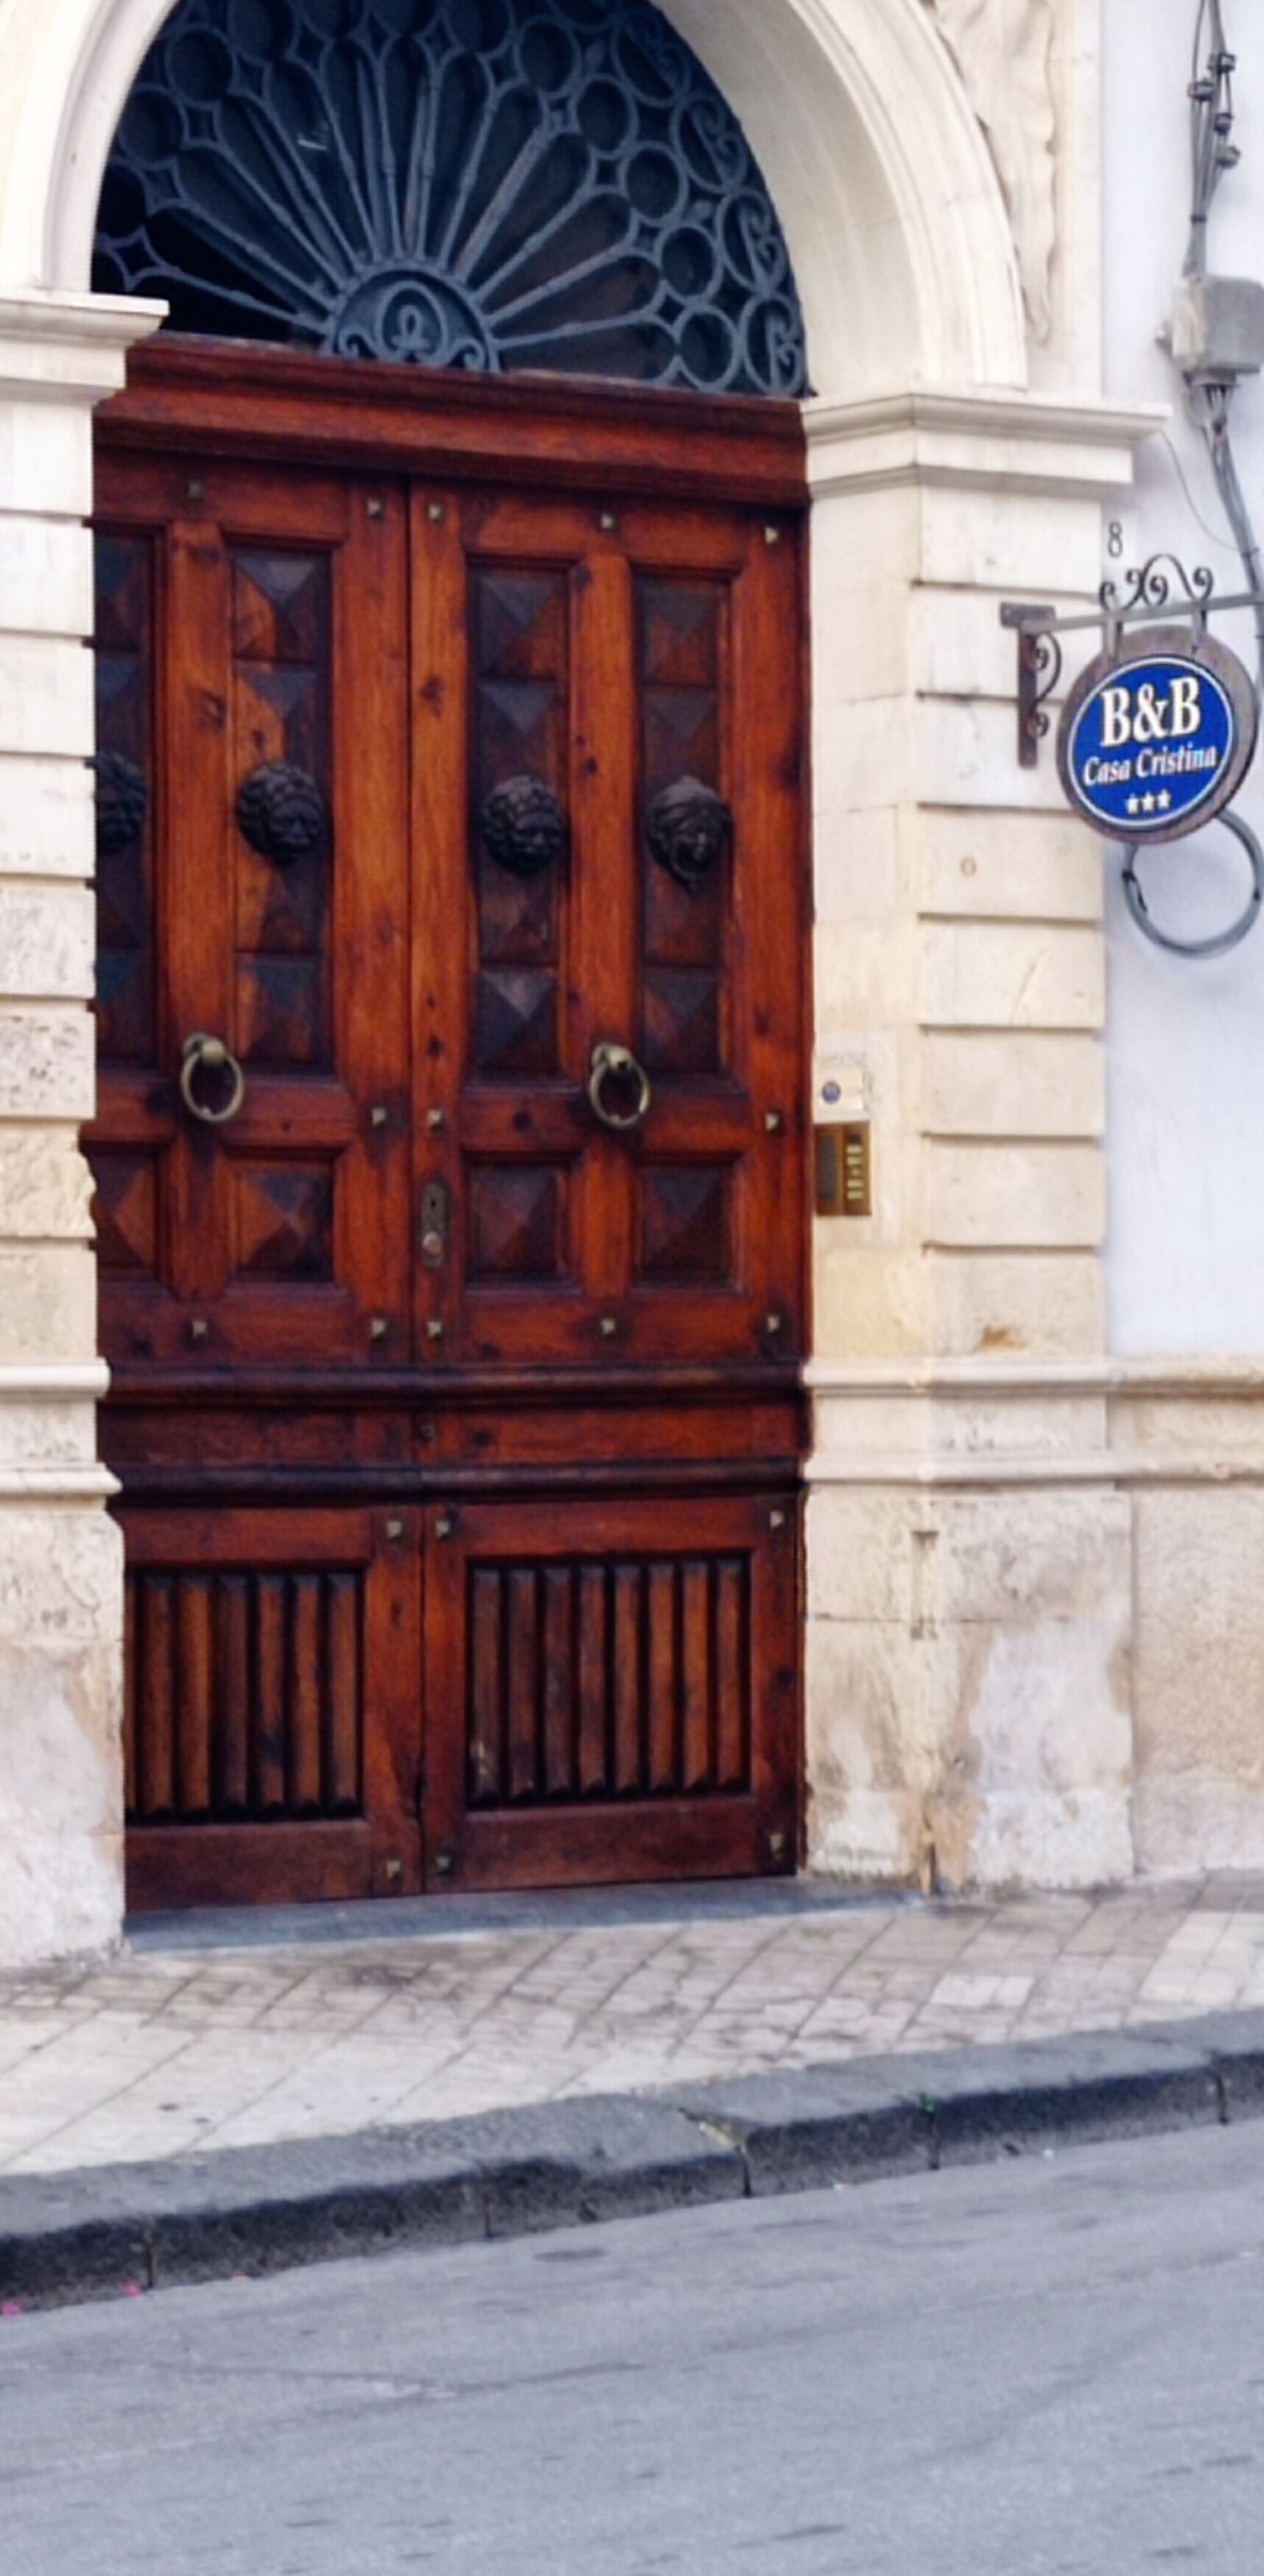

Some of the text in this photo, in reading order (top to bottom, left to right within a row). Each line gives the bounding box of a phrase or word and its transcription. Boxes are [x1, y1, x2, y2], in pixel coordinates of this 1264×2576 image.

[1107, 520, 1123, 559] 8
[1100, 676, 1201, 747] B&B
[1084, 741, 1217, 786] Casa Cristina
